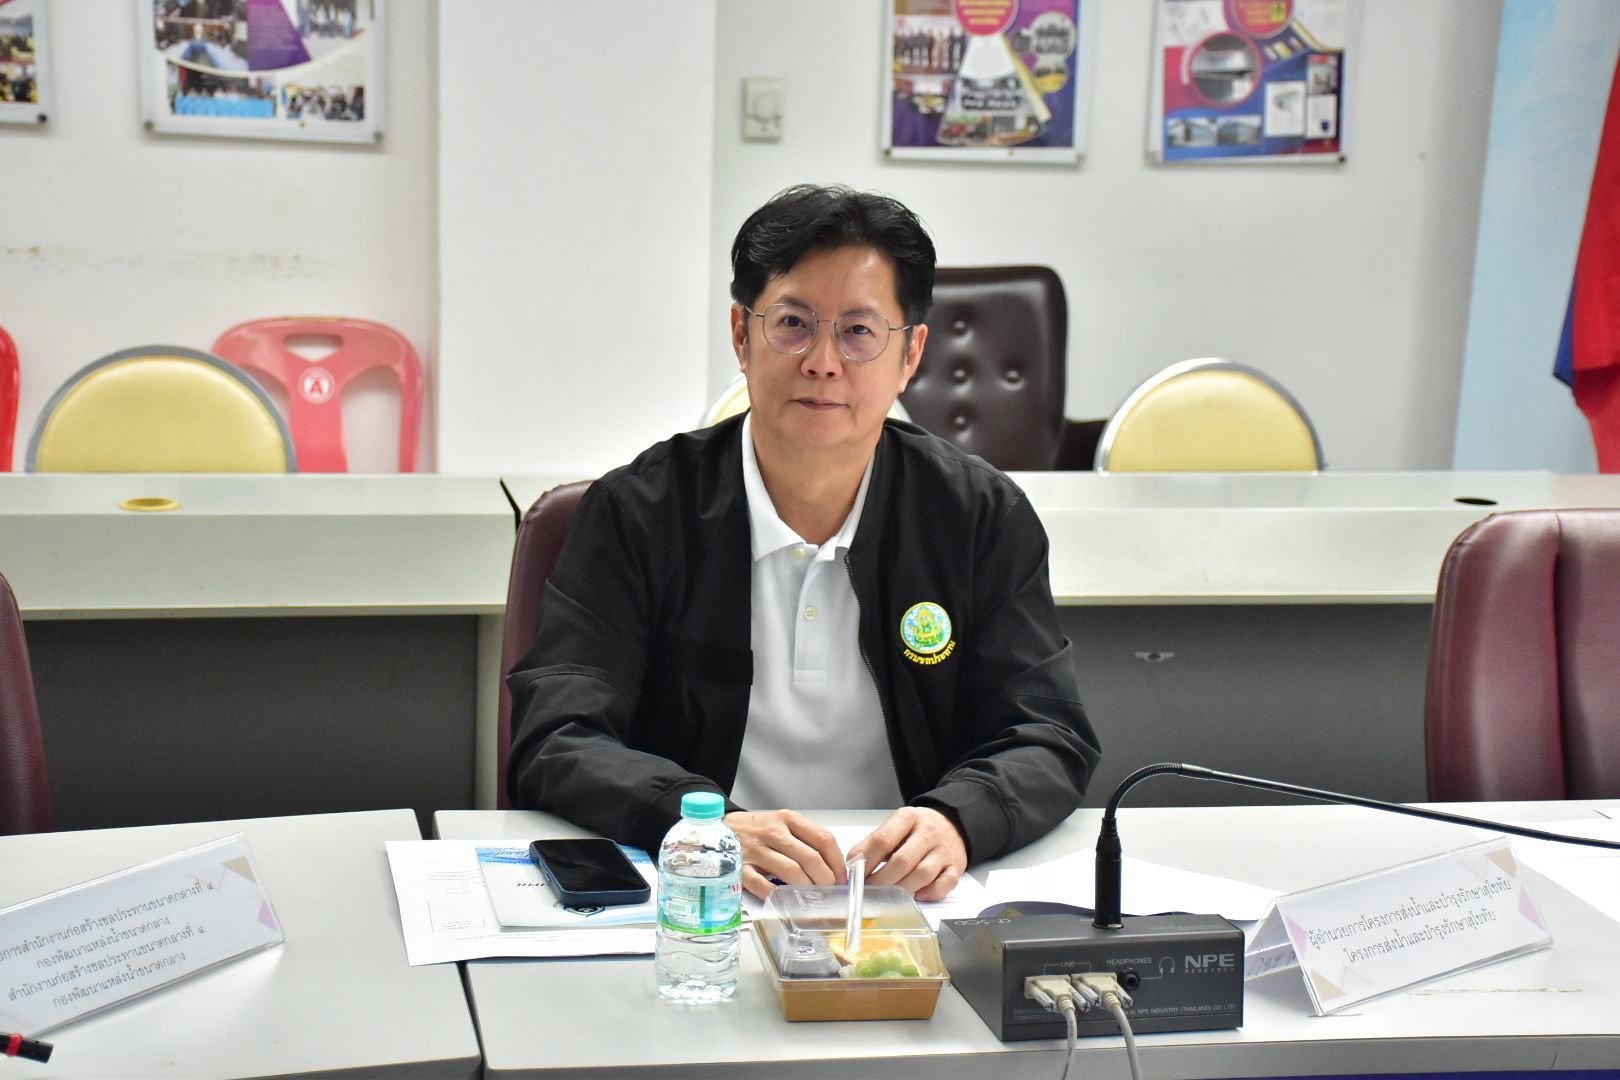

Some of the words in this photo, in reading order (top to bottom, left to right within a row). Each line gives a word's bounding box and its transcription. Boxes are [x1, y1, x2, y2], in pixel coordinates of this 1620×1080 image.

[1308, 876, 1512, 950] ผู้อำนวยการโครงการส่งน้ำและบำรุงรักษาสุโขทัย
[1343, 907, 1497, 963] โครงการส่งน้ำและบำรุงรักษาสุโขทัย
[8, 922, 194, 1002] สำนักงานก่อสร้างชลประทานขนาดกลางที่
[36, 915, 171, 969] กองพัฒนาแหล่งน้ำขนาดกลาง
[1106, 957, 1152, 966] HEADPHONES
[1184, 954, 1235, 968] NPE
[53, 951, 187, 1008] กองพัฒนาแหล่งน้ำขนาดกลาง
